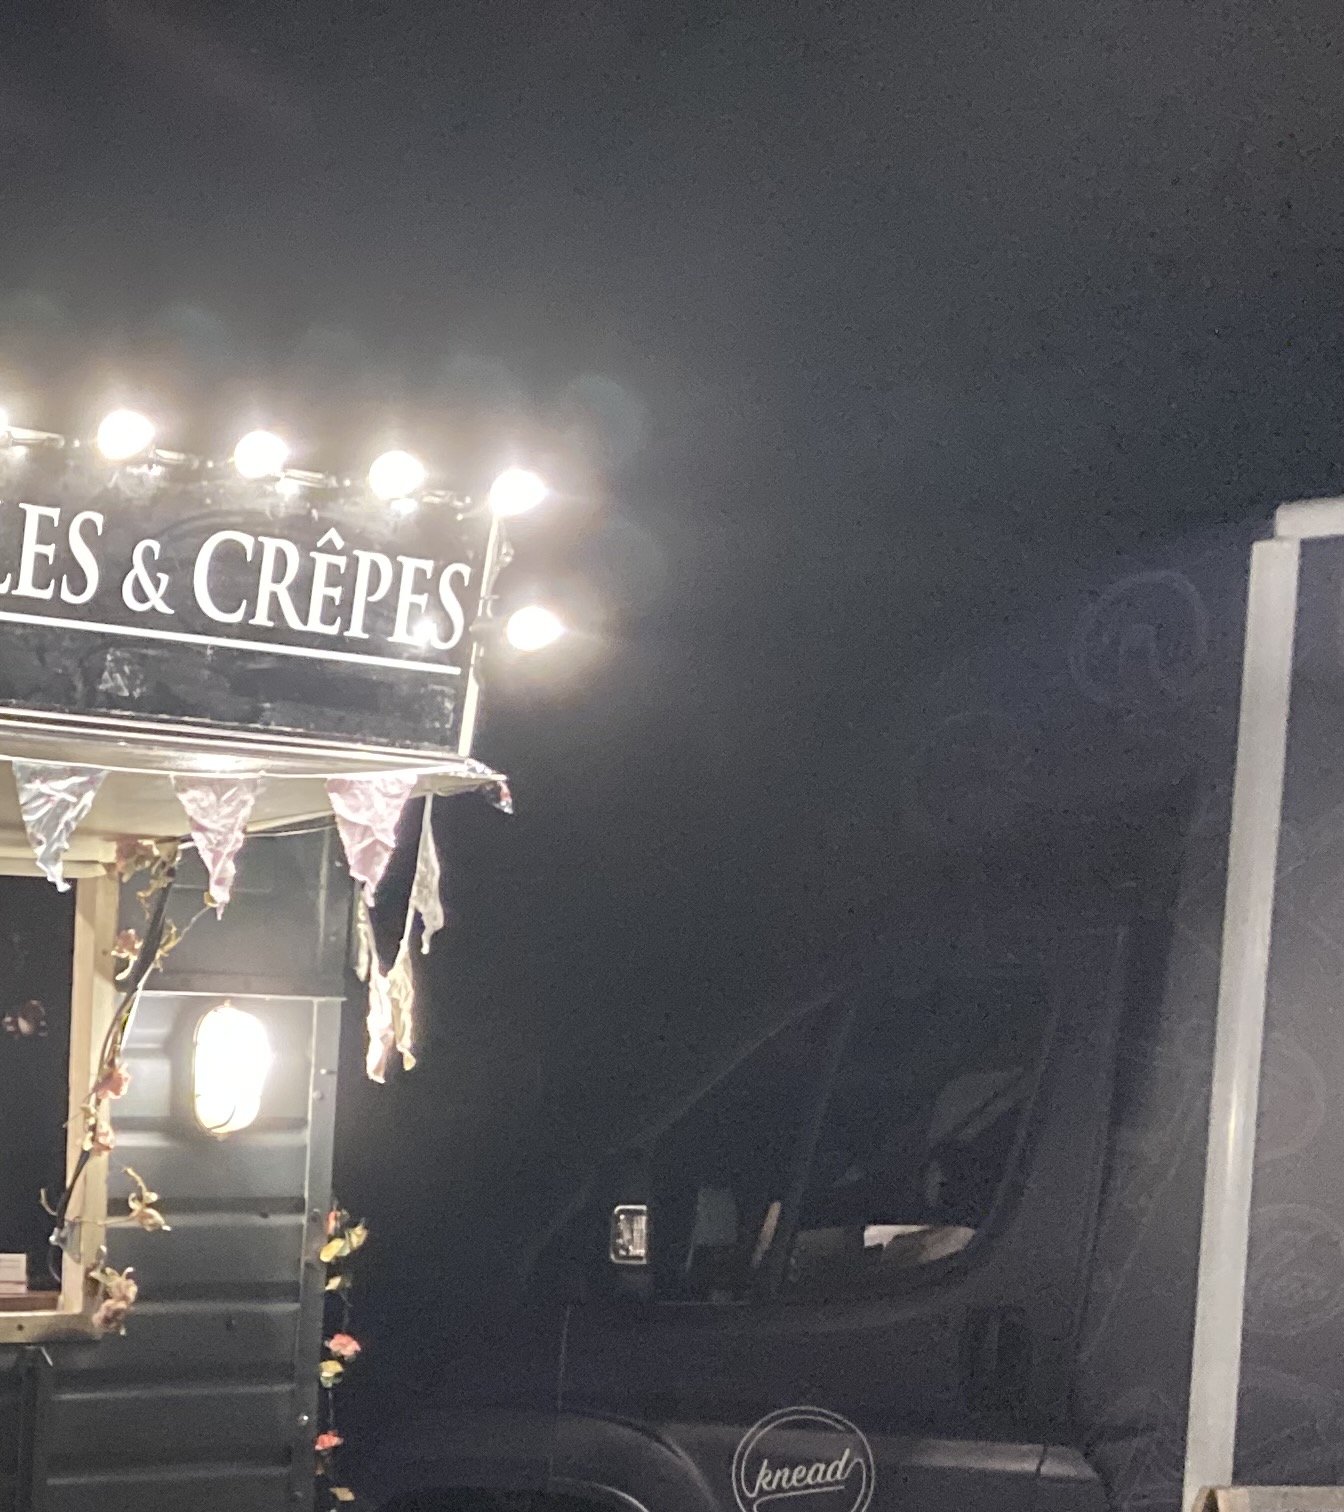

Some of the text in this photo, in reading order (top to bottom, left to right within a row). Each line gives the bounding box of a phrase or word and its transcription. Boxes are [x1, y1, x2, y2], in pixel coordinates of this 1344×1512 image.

[122, 538, 175, 614] &
[193, 526, 472, 652] CRÊPES
[757, 1447, 850, 1491] knead
